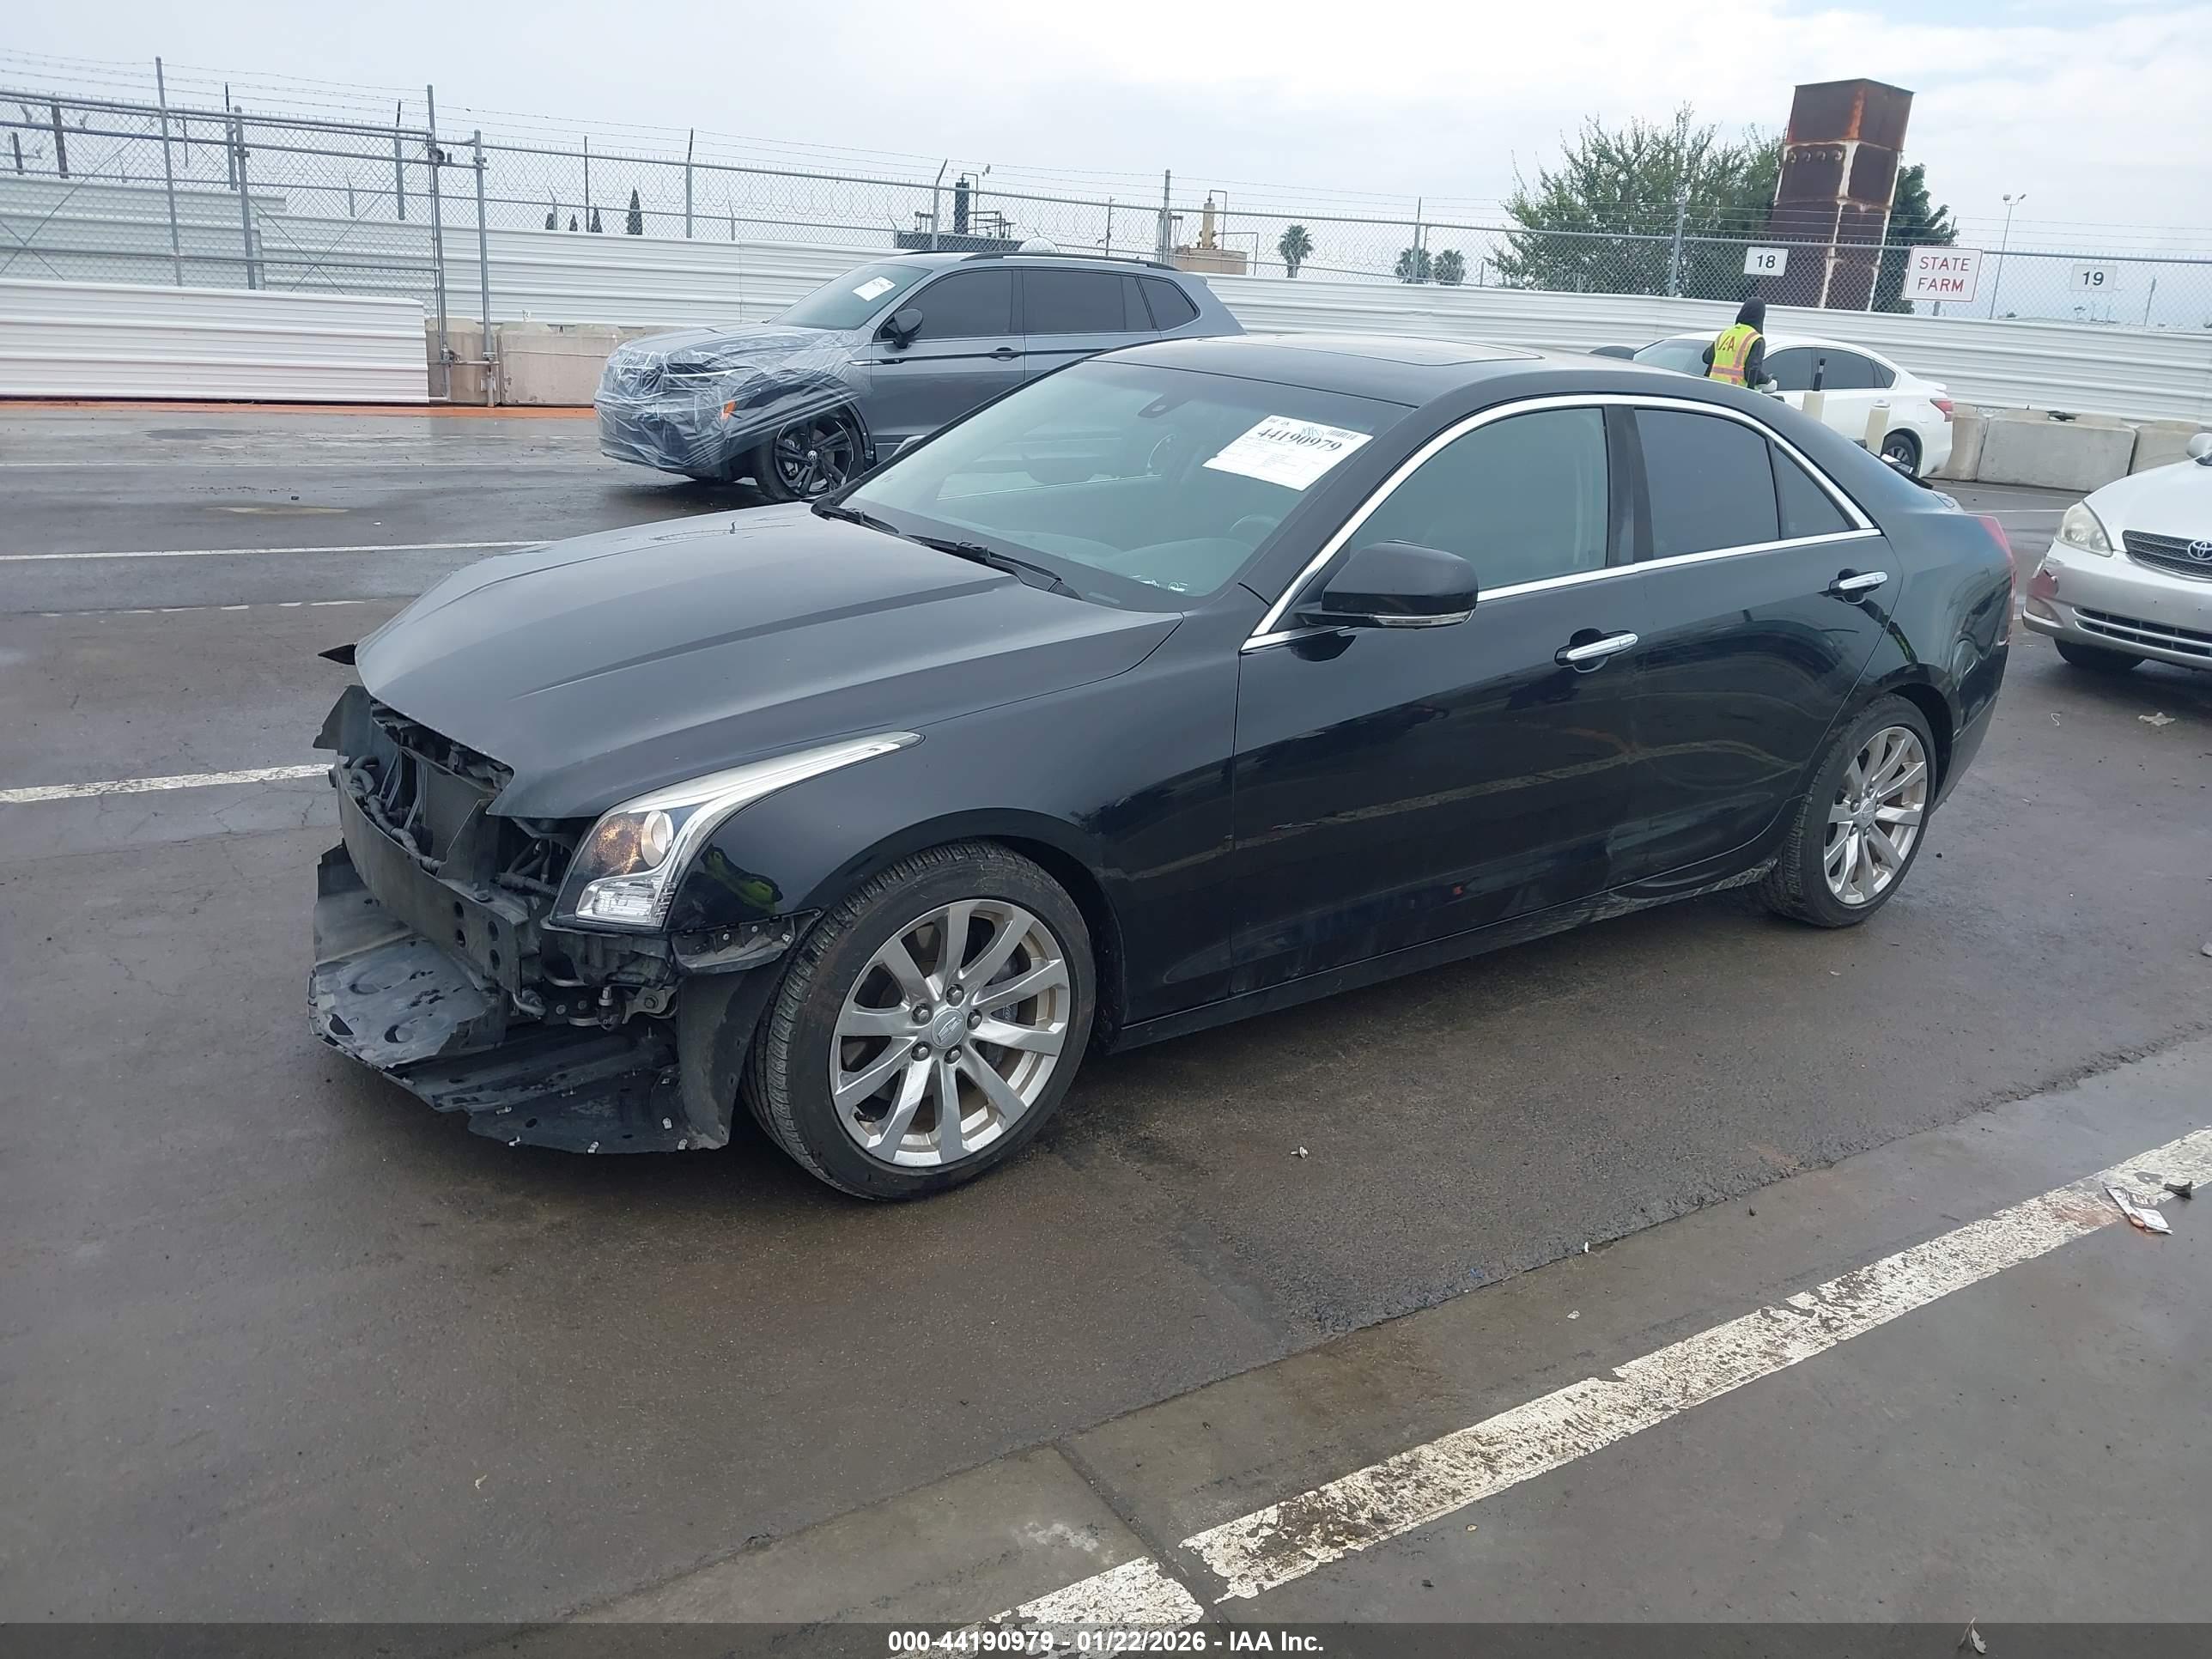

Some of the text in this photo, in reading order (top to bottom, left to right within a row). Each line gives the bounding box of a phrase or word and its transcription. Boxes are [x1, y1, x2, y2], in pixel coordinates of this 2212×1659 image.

[1756, 254, 1776, 269] 18
[1919, 256, 1971, 271] STATE
[1917, 277, 1964, 293] FARM
[2082, 270, 2105, 286] 19
[1257, 428, 1343, 452] 44190979
